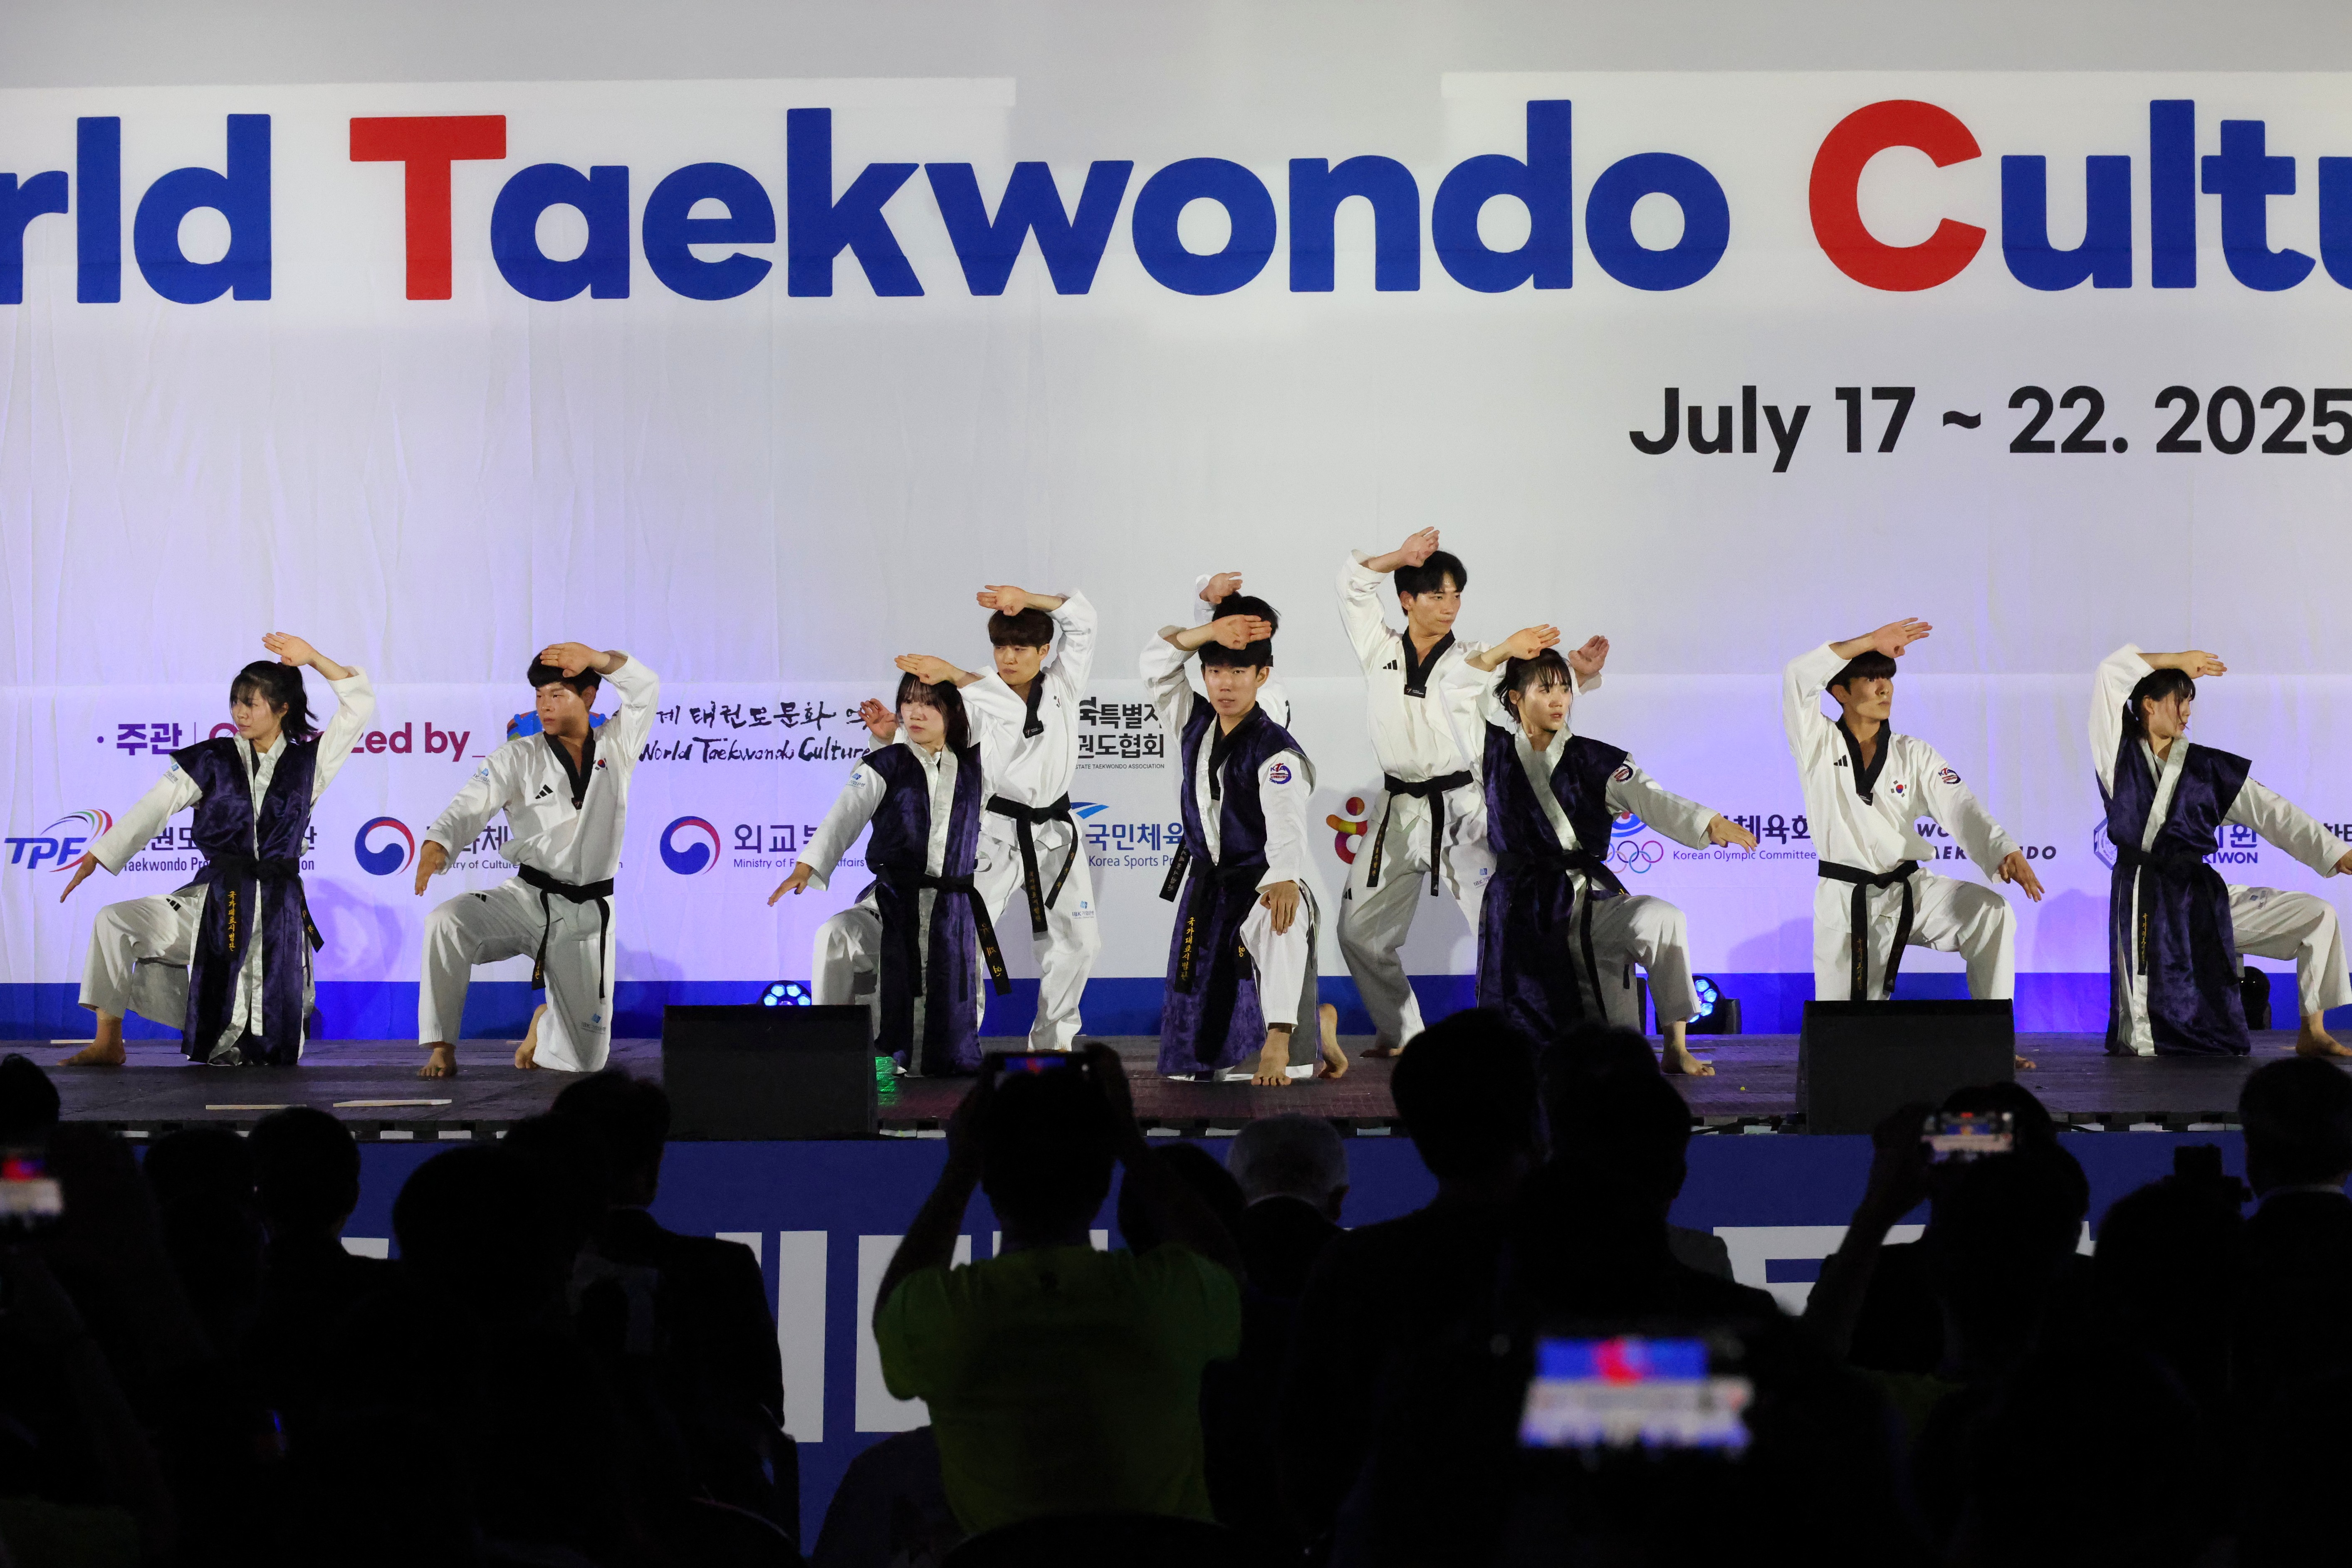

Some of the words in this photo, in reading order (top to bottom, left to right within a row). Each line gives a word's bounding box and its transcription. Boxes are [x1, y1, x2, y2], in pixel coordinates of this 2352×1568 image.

[350, 99, 1730, 302] Taekwondo
[1809, 99, 2352, 292] Cult
[1629, 385, 1811, 473] July
[1835, 387, 1916, 453] 17
[2008, 385, 2128, 453] 22.
[2155, 385, 2352, 454] 2025
[116, 723, 183, 755] 주관
[639, 740, 693, 762] World
[692, 737, 795, 764] Taekwondo
[1078, 733, 1164, 759] 권도협회
[4, 837, 87, 869] TPF
[469, 860, 478, 869] of
[734, 858, 772, 869] Ministry
[776, 858, 786, 867] of
[1089, 855, 1120, 866] Korea
[1124, 855, 1158, 869] Sports
[1674, 849, 1710, 859] Korean
[1714, 850, 1756, 862] Olympic
[1759, 850, 1816, 859] Committee
